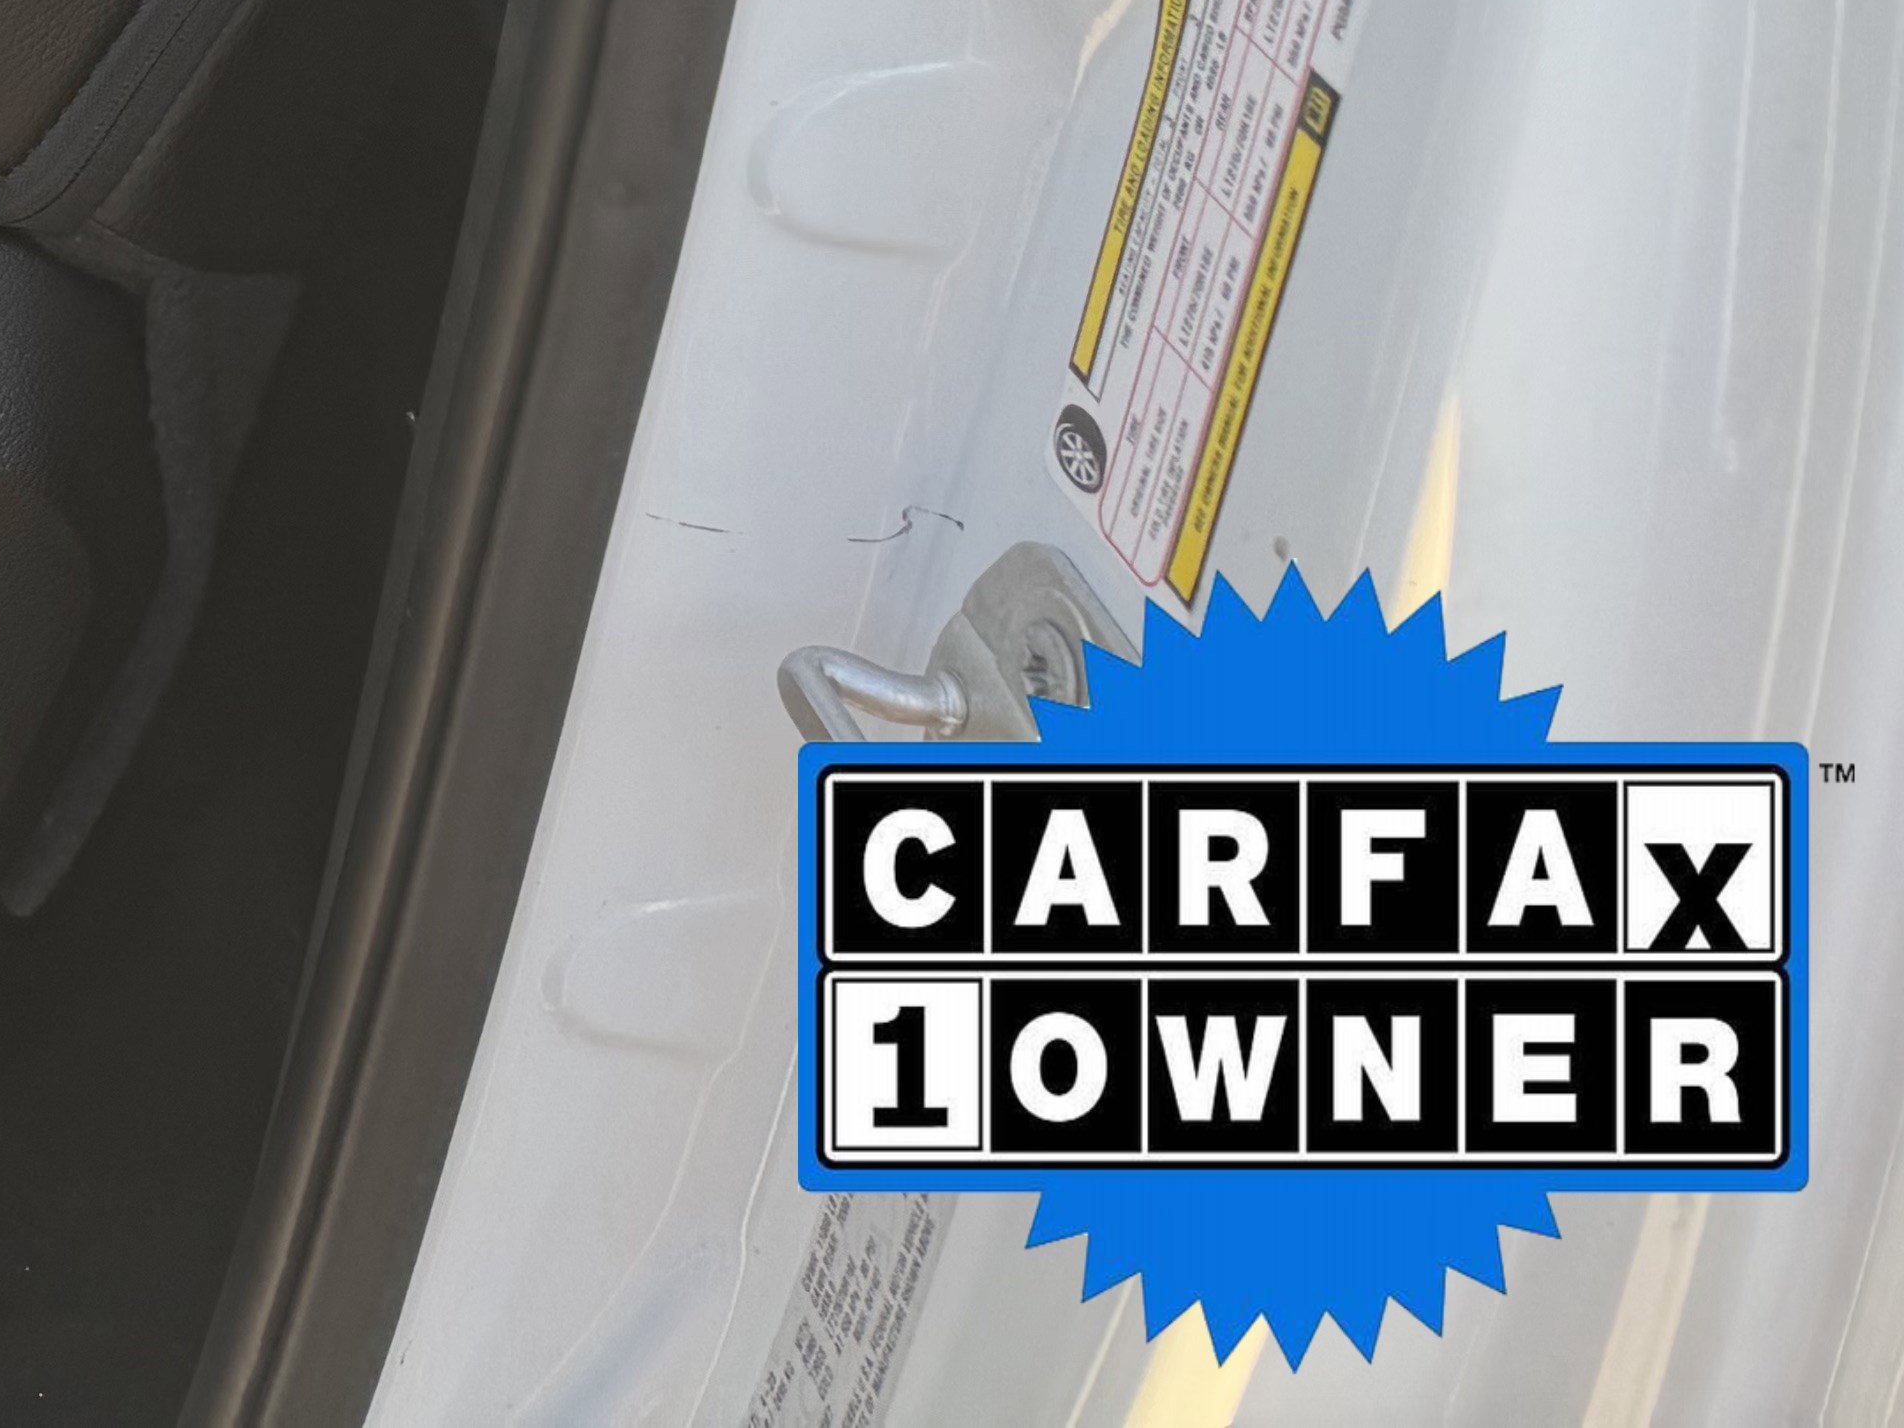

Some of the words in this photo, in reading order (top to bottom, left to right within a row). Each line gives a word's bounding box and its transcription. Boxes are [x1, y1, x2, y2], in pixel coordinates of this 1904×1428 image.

[1114, 199, 1130, 235] TIRE
[1124, 162, 1140, 197] AND
[1134, 93, 1156, 159] LOADING
